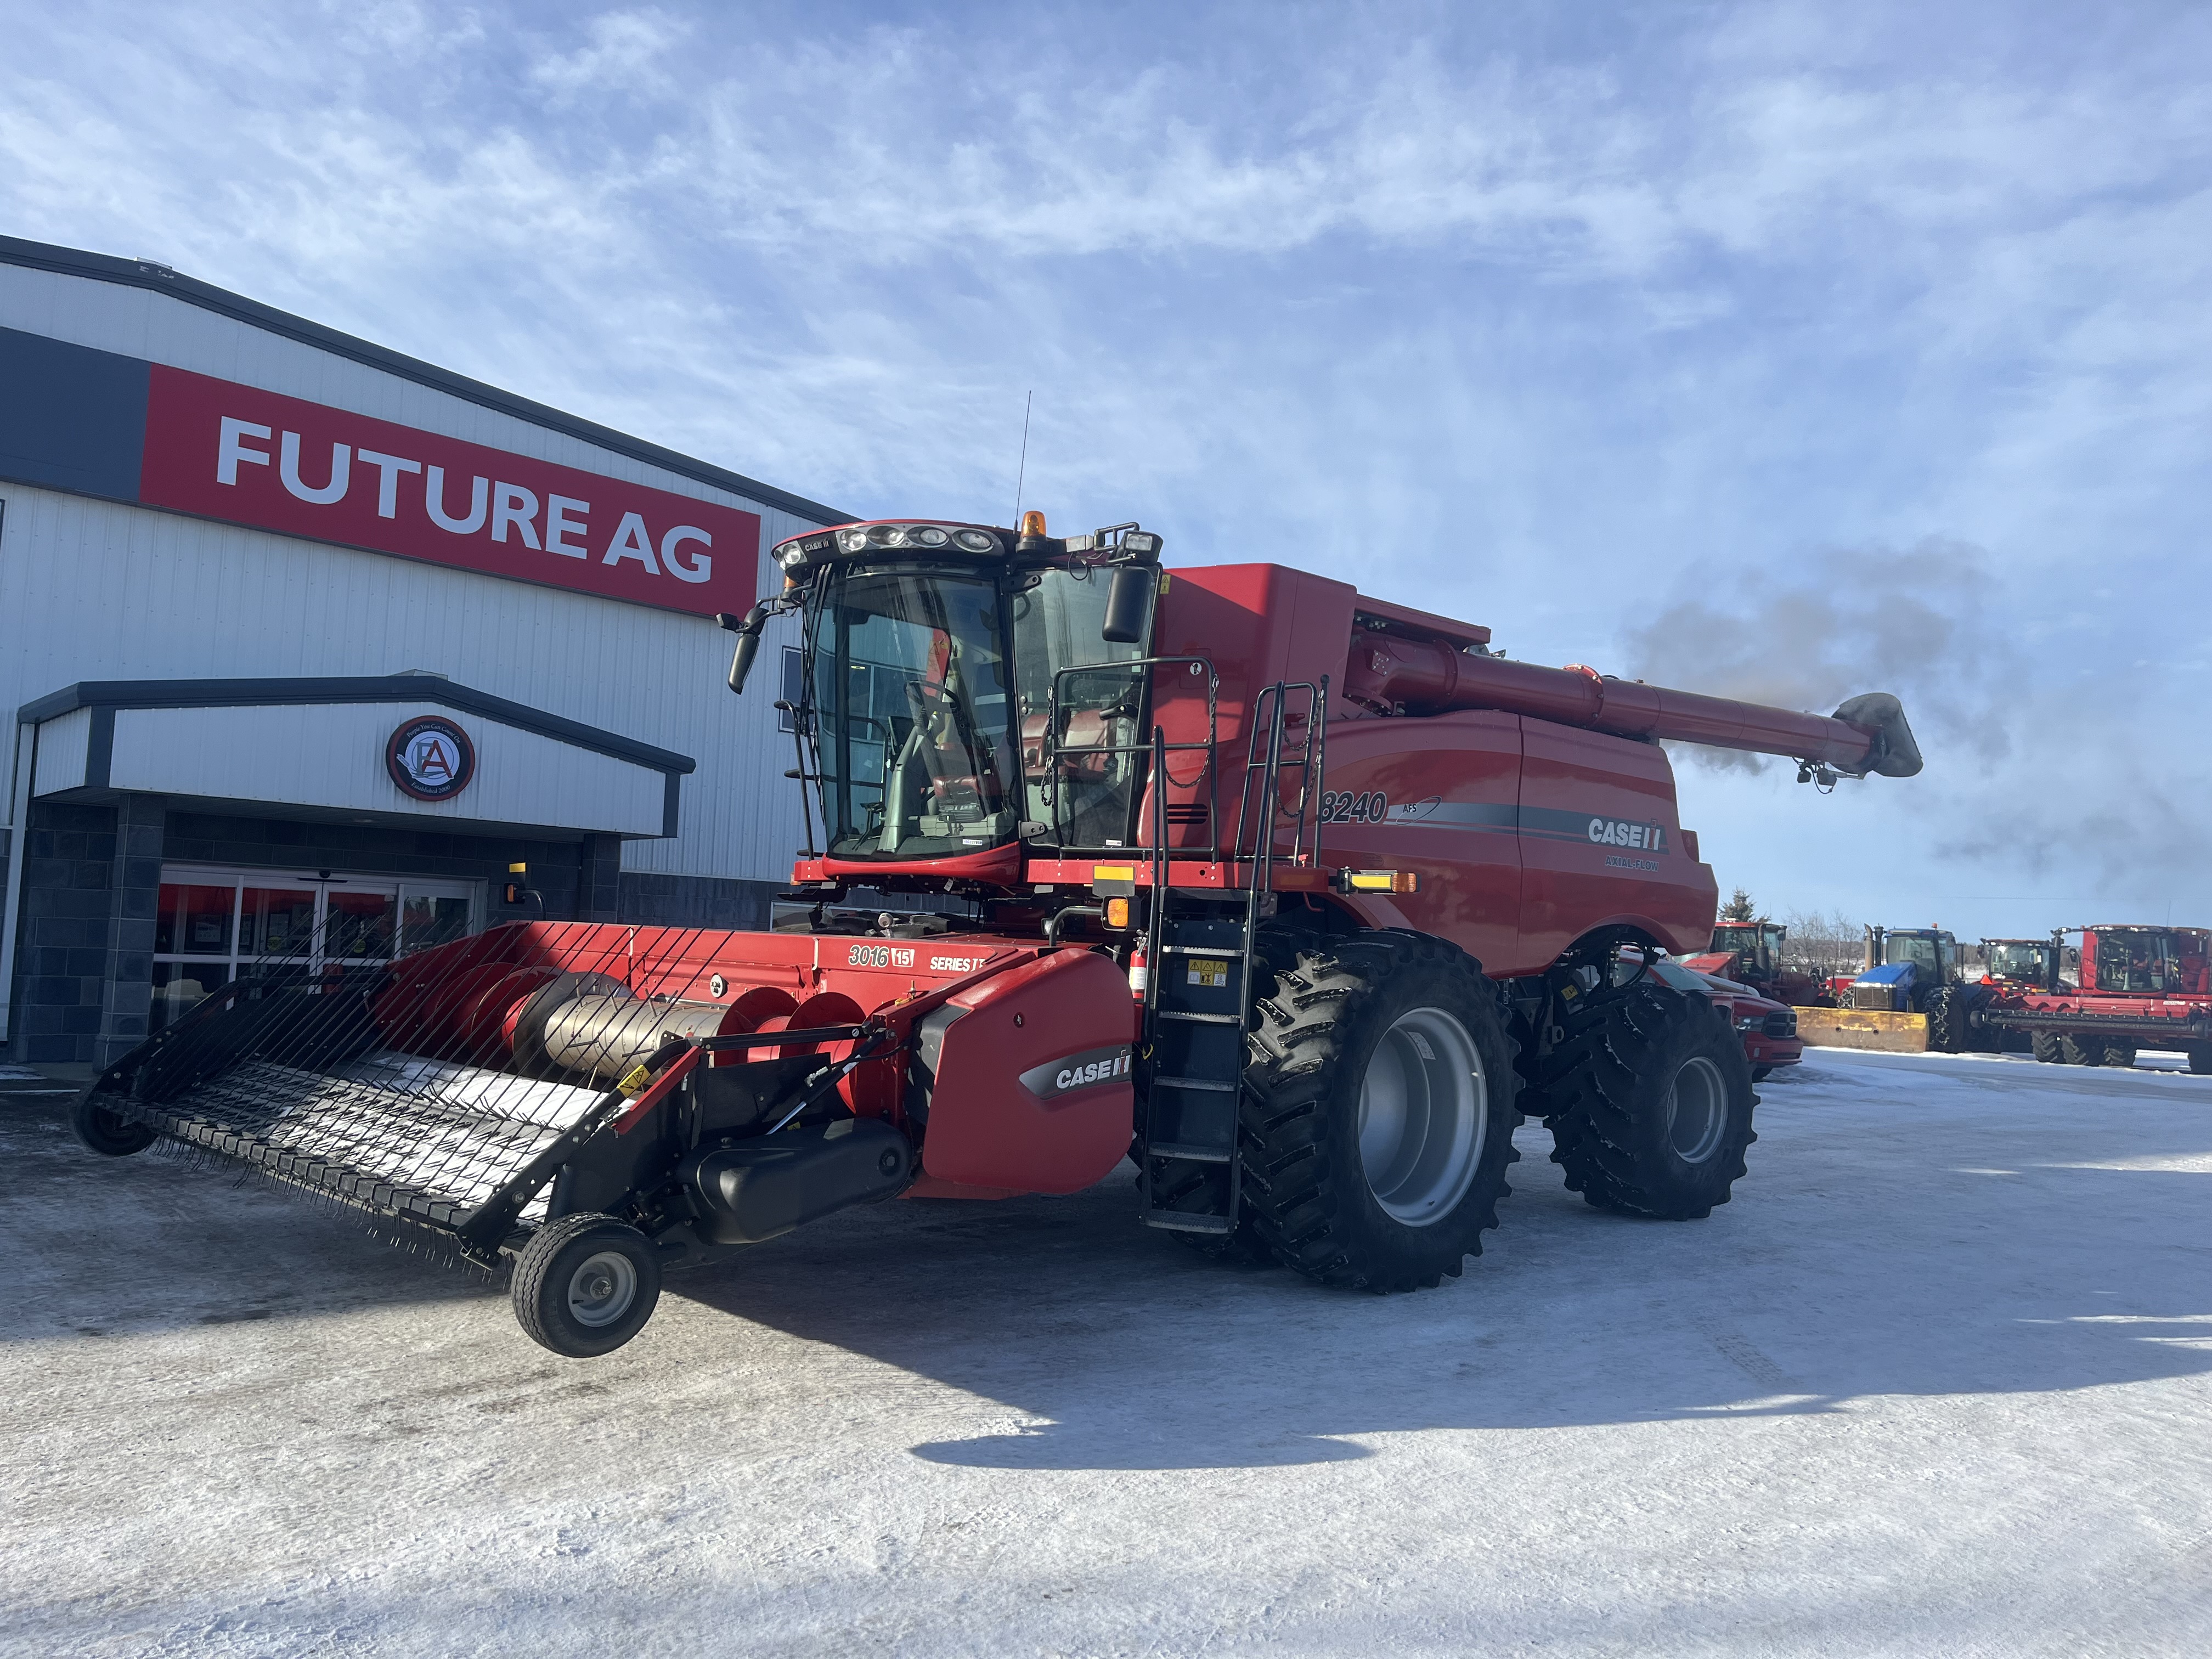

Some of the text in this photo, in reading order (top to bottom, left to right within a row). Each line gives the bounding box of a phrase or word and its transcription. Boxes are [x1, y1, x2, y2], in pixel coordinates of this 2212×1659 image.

[217, 415, 712, 584] FUTURE AG
[805, 541, 822, 551] CASE
[407, 726, 420, 737] People
[442, 726, 454, 737] Count
[411, 782, 450, 794] Established 2000
[1321, 790, 1387, 823] 8240
[1402, 804, 1417, 813] AFS
[1588, 818, 1643, 848] CASE
[1605, 855, 1659, 872] AXIAL-FLOW
[849, 944, 909, 968] 3016 15
[930, 956, 970, 972] SERIES
[1056, 1059, 1111, 1089] CASE
